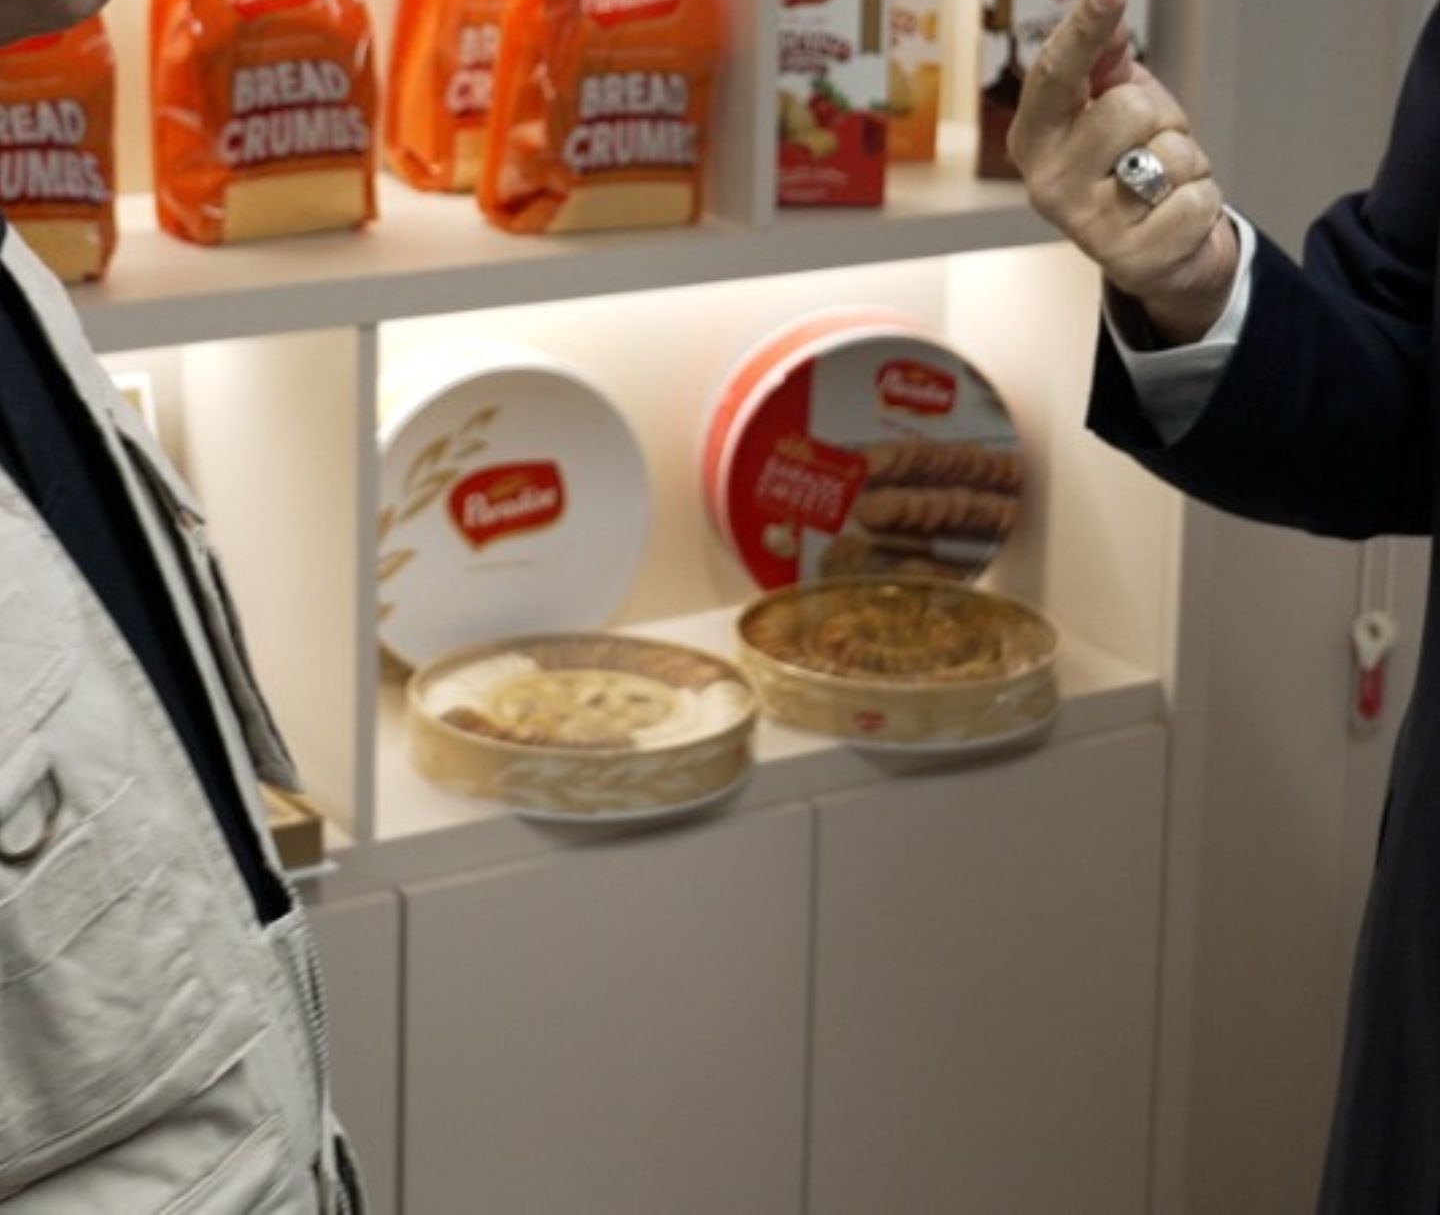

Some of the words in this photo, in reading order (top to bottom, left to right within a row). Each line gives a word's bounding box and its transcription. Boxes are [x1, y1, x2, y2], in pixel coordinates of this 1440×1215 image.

[231, 60, 350, 116] BREAD
[580, 70, 689, 119] BREAD
[215, 105, 370, 165] CRUMBS
[463, 485, 558, 530] Paradise
